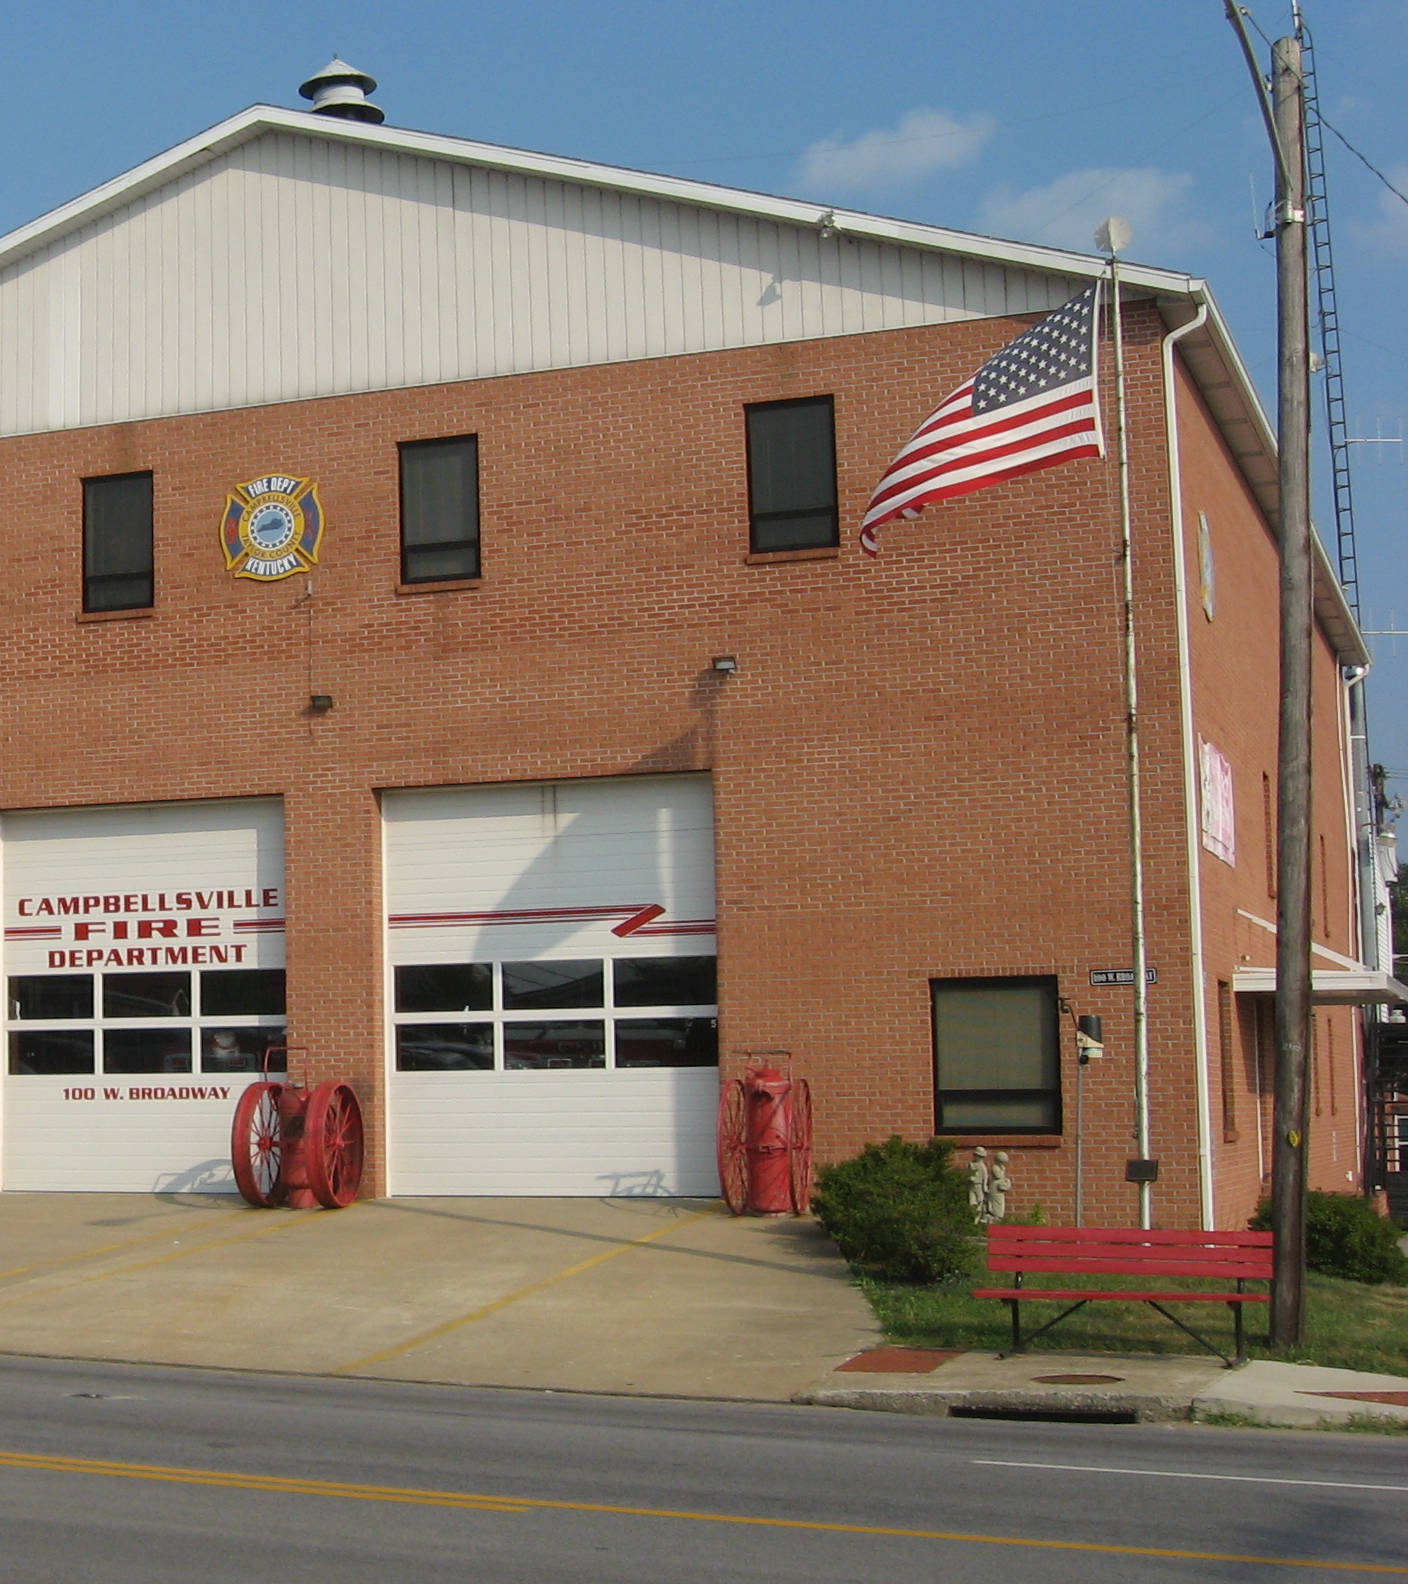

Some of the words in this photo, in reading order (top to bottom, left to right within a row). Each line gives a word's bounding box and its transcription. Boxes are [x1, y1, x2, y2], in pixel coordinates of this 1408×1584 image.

[248, 478, 268, 498] FIRE
[271, 477, 296, 494] DEPT
[245, 553, 297, 576] KENTUCKY
[18, 888, 279, 917] CAMPBELLSVILLE
[73, 917, 222, 941] FIRE
[48, 944, 247, 969] DEPARTMENT
[63, 1087, 96, 1101] 100
[103, 1087, 124, 1100] W.
[128, 1086, 231, 1100] BROADWAY
